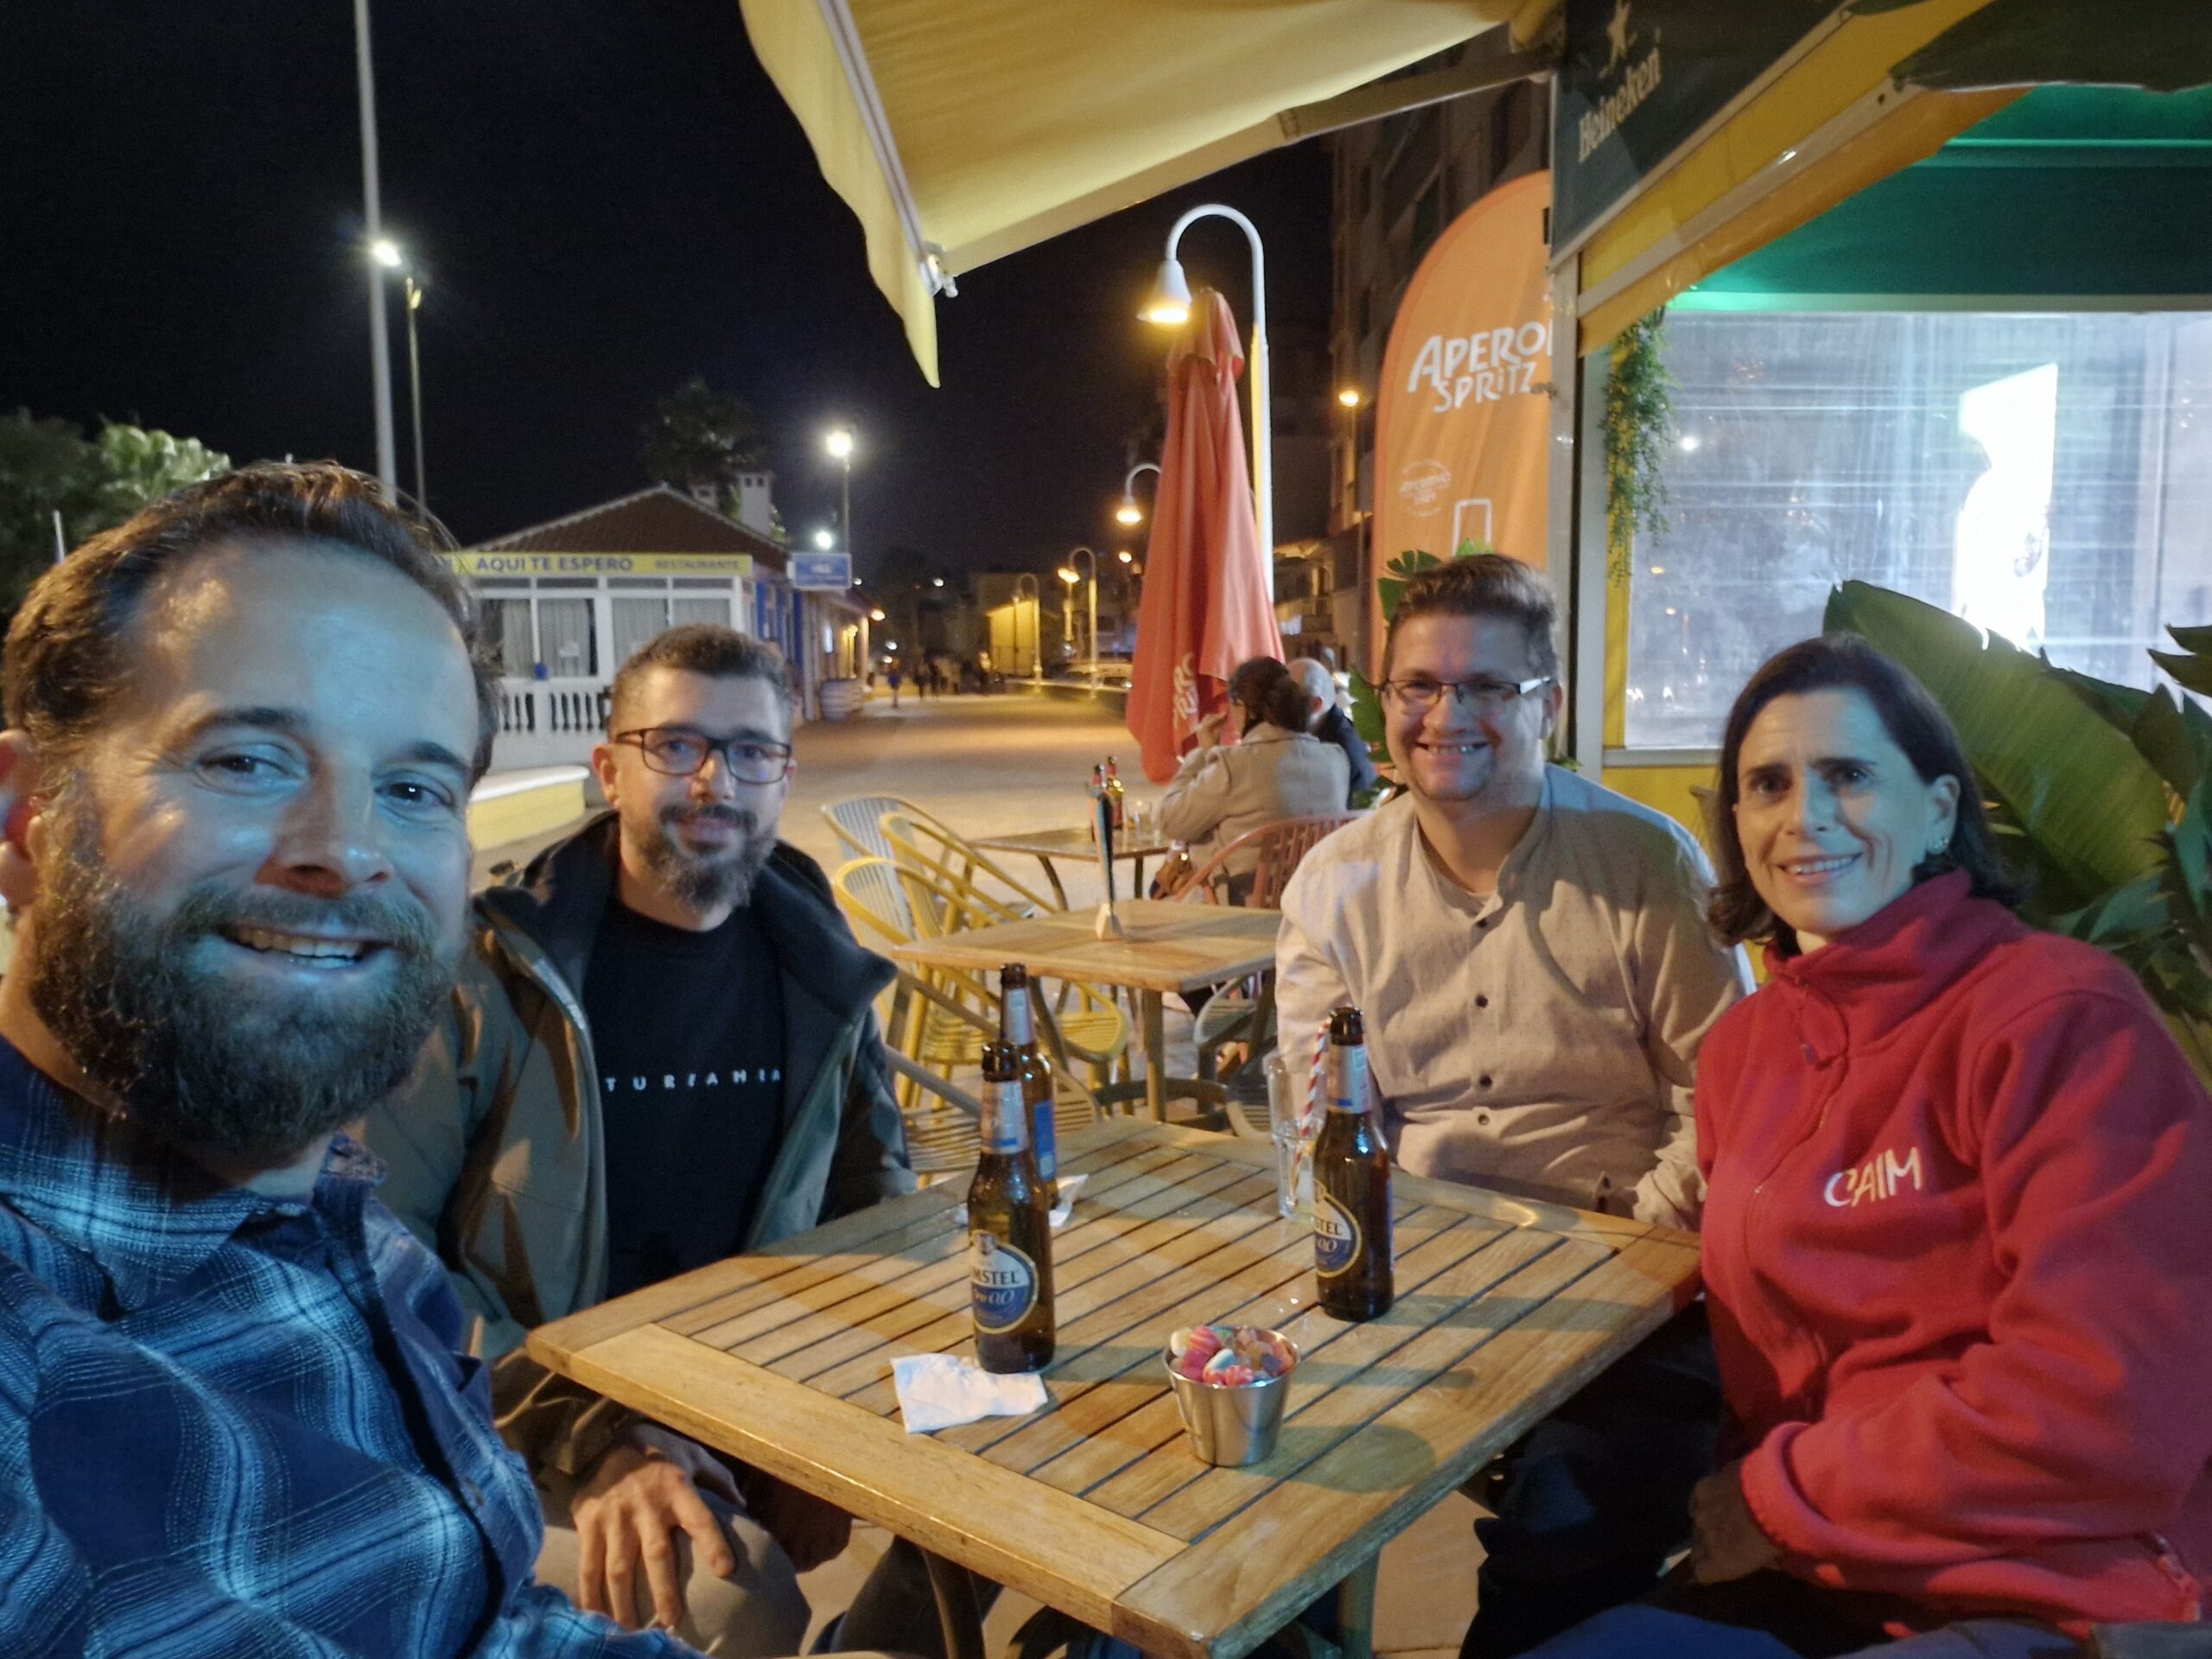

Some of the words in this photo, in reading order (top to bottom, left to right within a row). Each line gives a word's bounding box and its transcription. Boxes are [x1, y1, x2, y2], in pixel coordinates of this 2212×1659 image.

[531, 556, 552, 571] TE
[558, 556, 633, 571] ESPERO
[1823, 1146, 1923, 1208] CAIM
